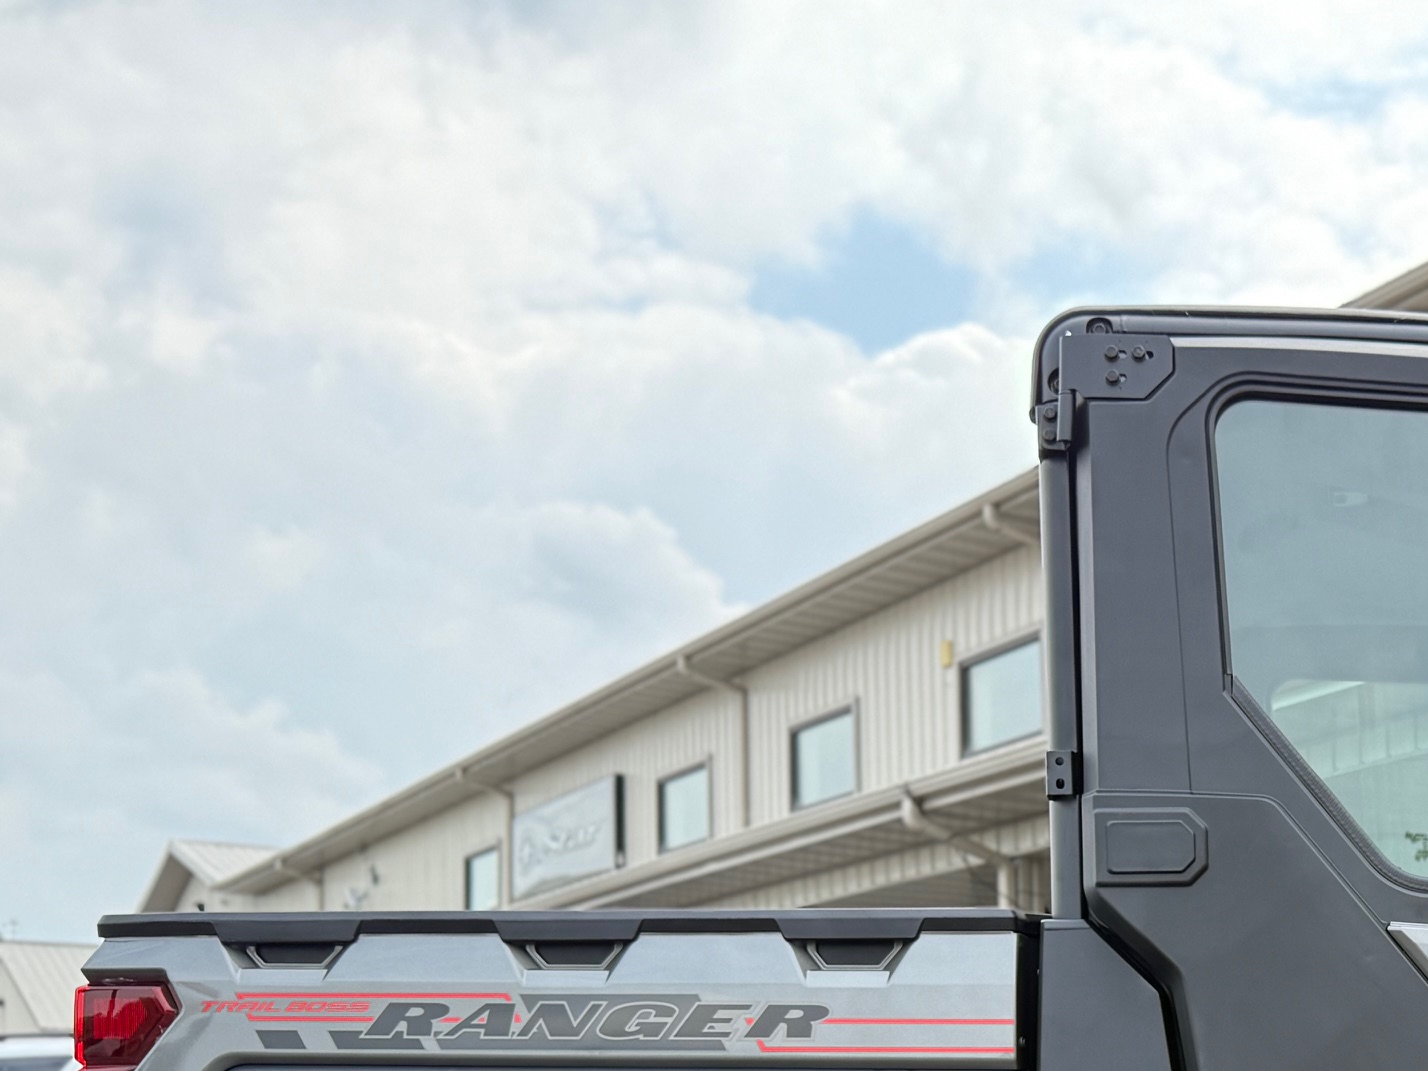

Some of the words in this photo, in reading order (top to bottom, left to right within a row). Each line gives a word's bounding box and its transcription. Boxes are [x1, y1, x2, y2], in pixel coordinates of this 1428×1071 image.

[200, 1000, 280, 1013] TRAIL
[284, 1000, 372, 1014] BOSS
[358, 1000, 832, 1042] RANGER
